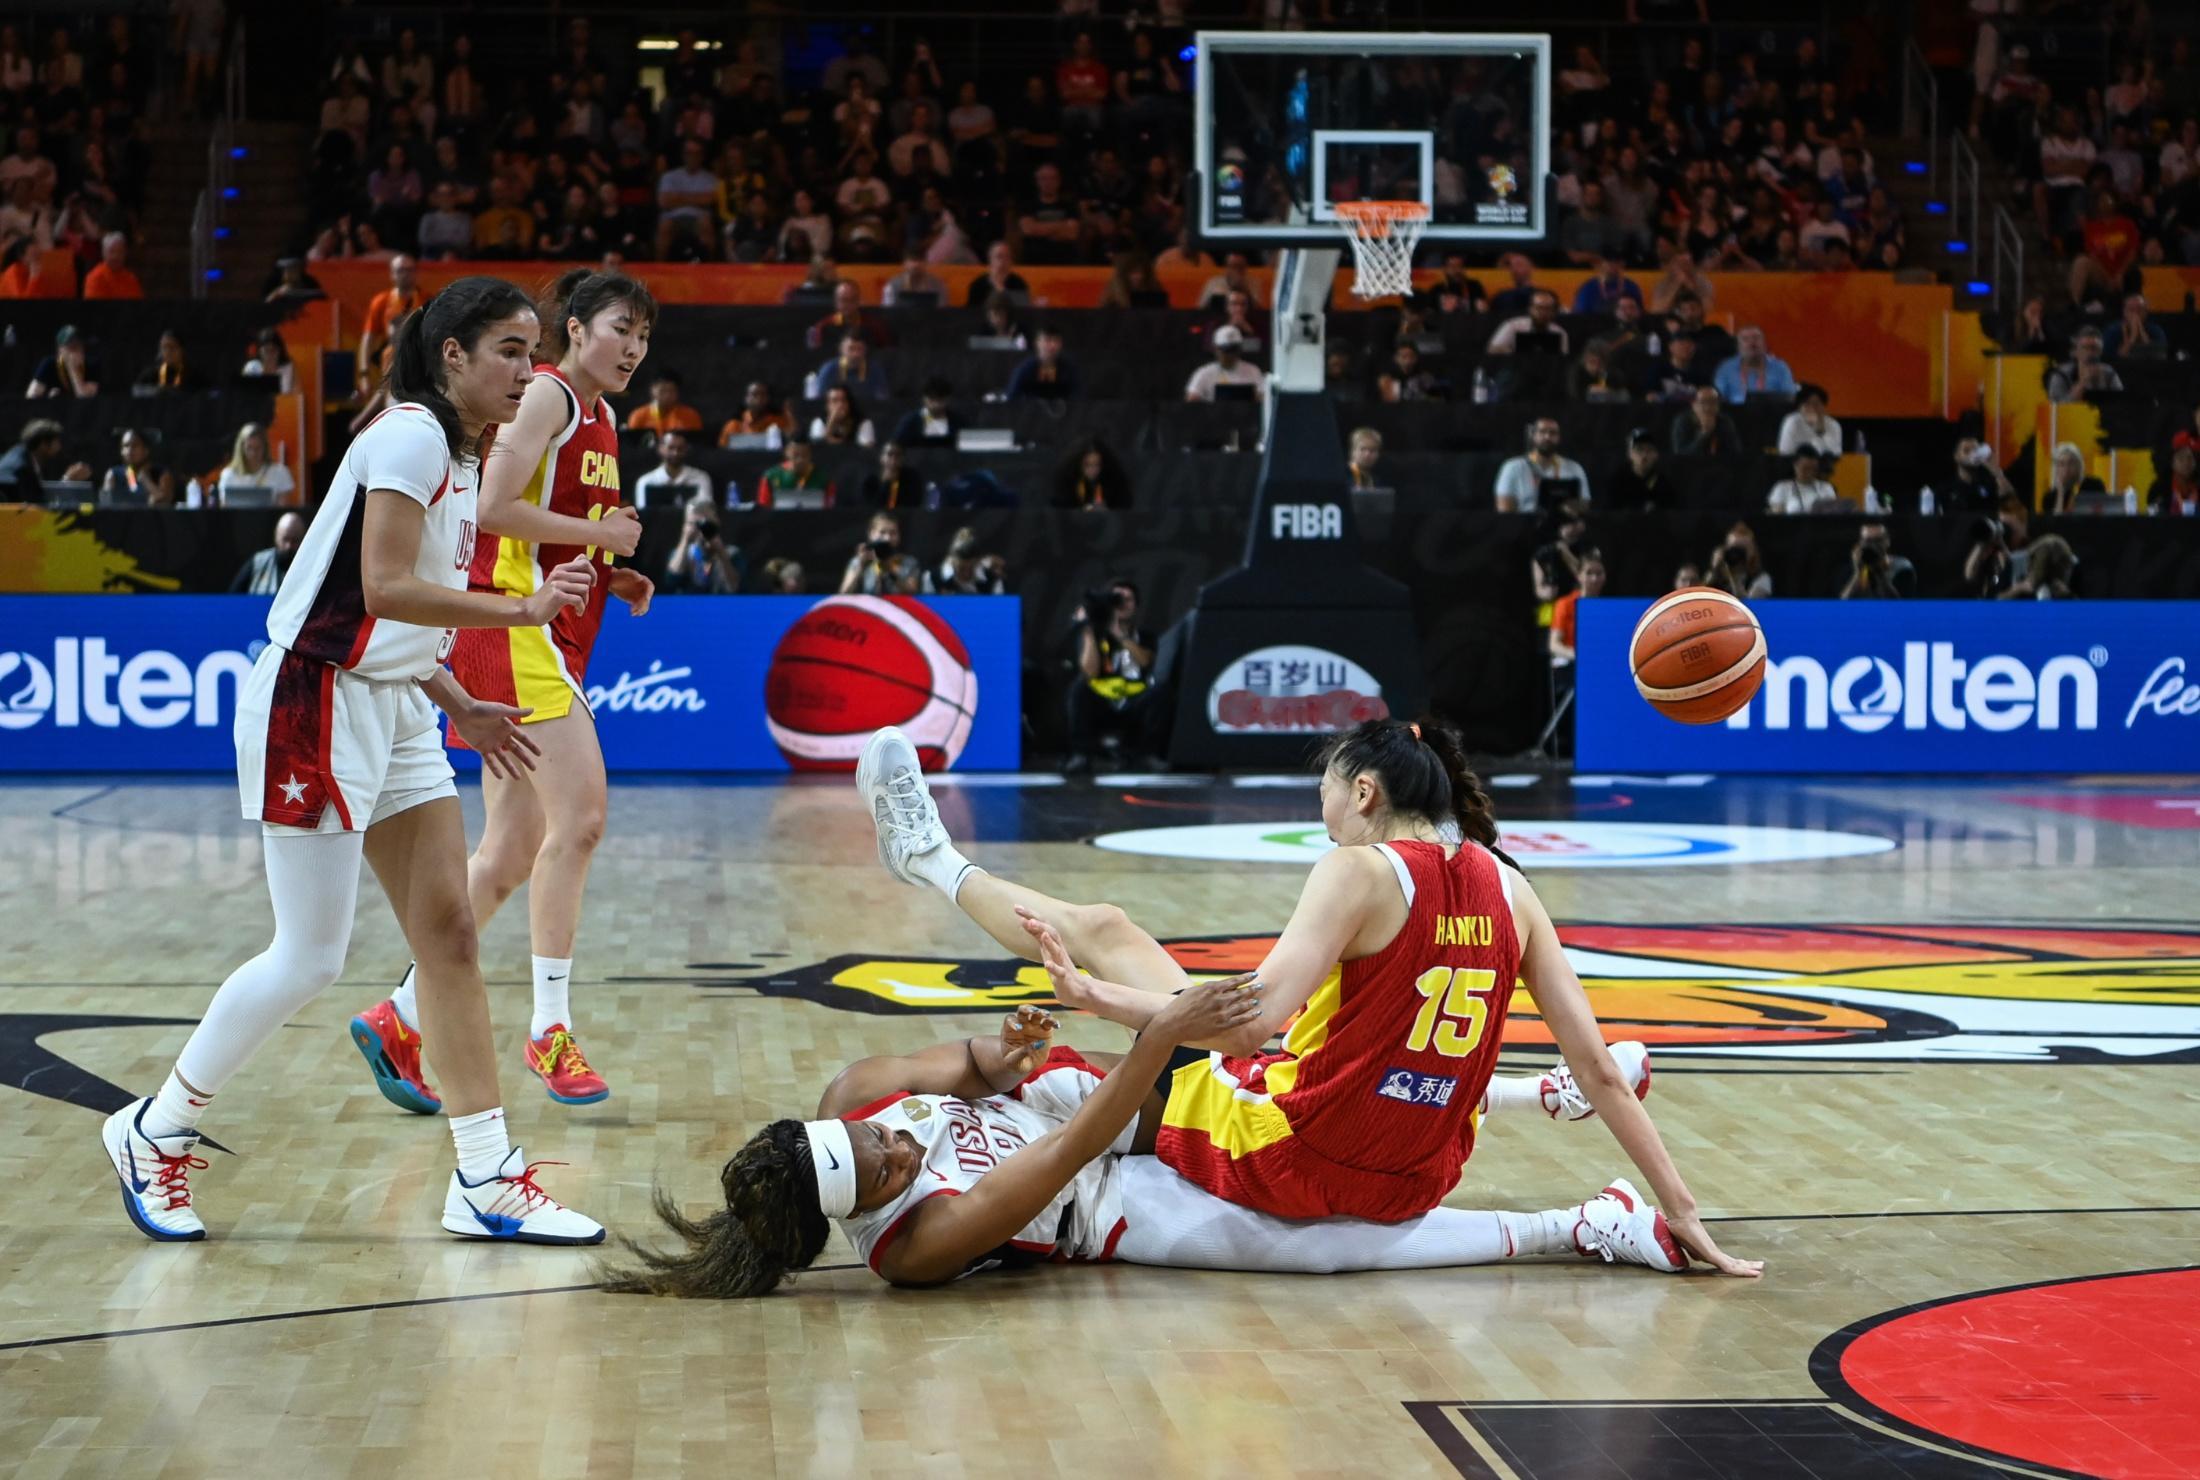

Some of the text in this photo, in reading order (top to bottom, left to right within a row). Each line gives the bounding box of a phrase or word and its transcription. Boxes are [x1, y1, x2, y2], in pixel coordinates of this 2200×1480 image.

[1272, 503, 1342, 539] FIBA
[1680, 641, 1711, 664] FIBA
[1244, 660, 1347, 687] 百岁山
[1406, 965, 1497, 1058] 15
[1412, 1077, 1457, 1106] 秀域
[938, 1100, 997, 1175] USA
